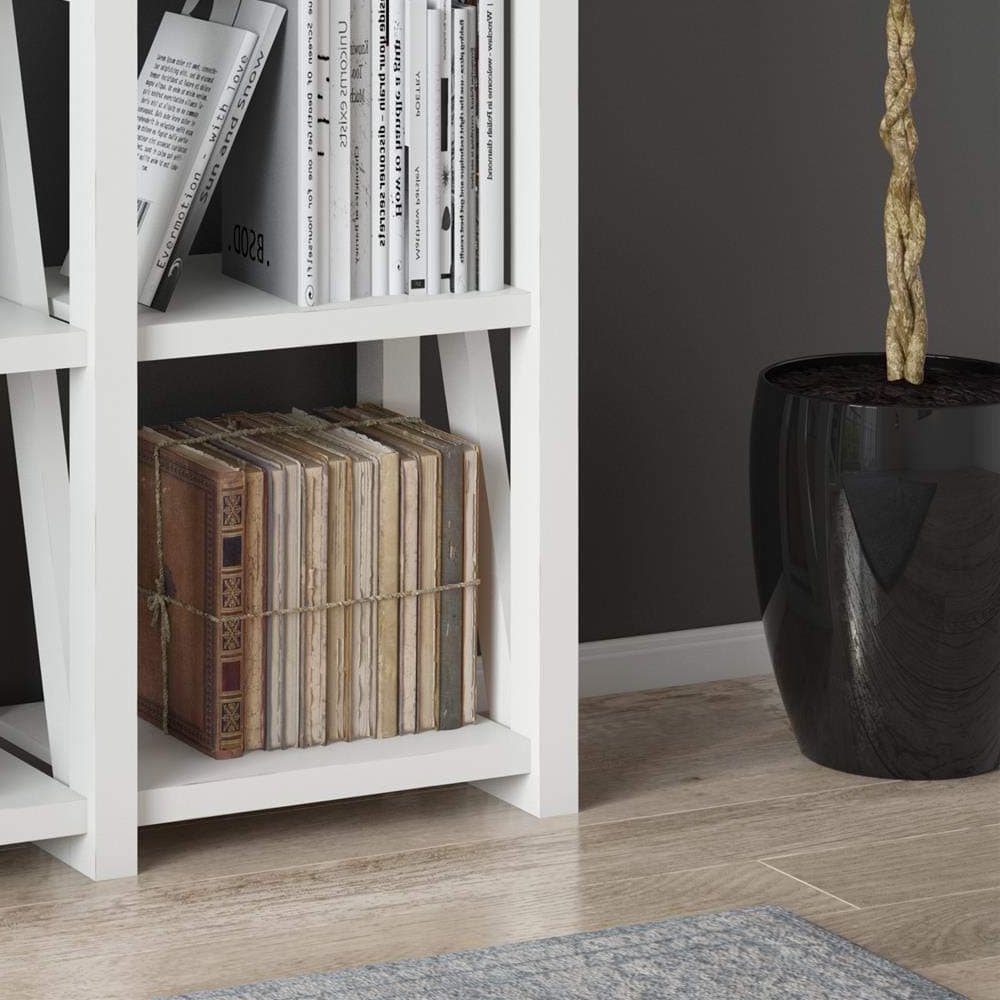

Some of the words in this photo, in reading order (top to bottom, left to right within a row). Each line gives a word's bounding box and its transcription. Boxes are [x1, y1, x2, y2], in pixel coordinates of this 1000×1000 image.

[156, 172, 201, 269] Evermotion
[209, 104, 229, 142] with
[227, 55, 250, 92] love
[199, 164, 220, 205] Sun
[219, 116, 238, 157] and
